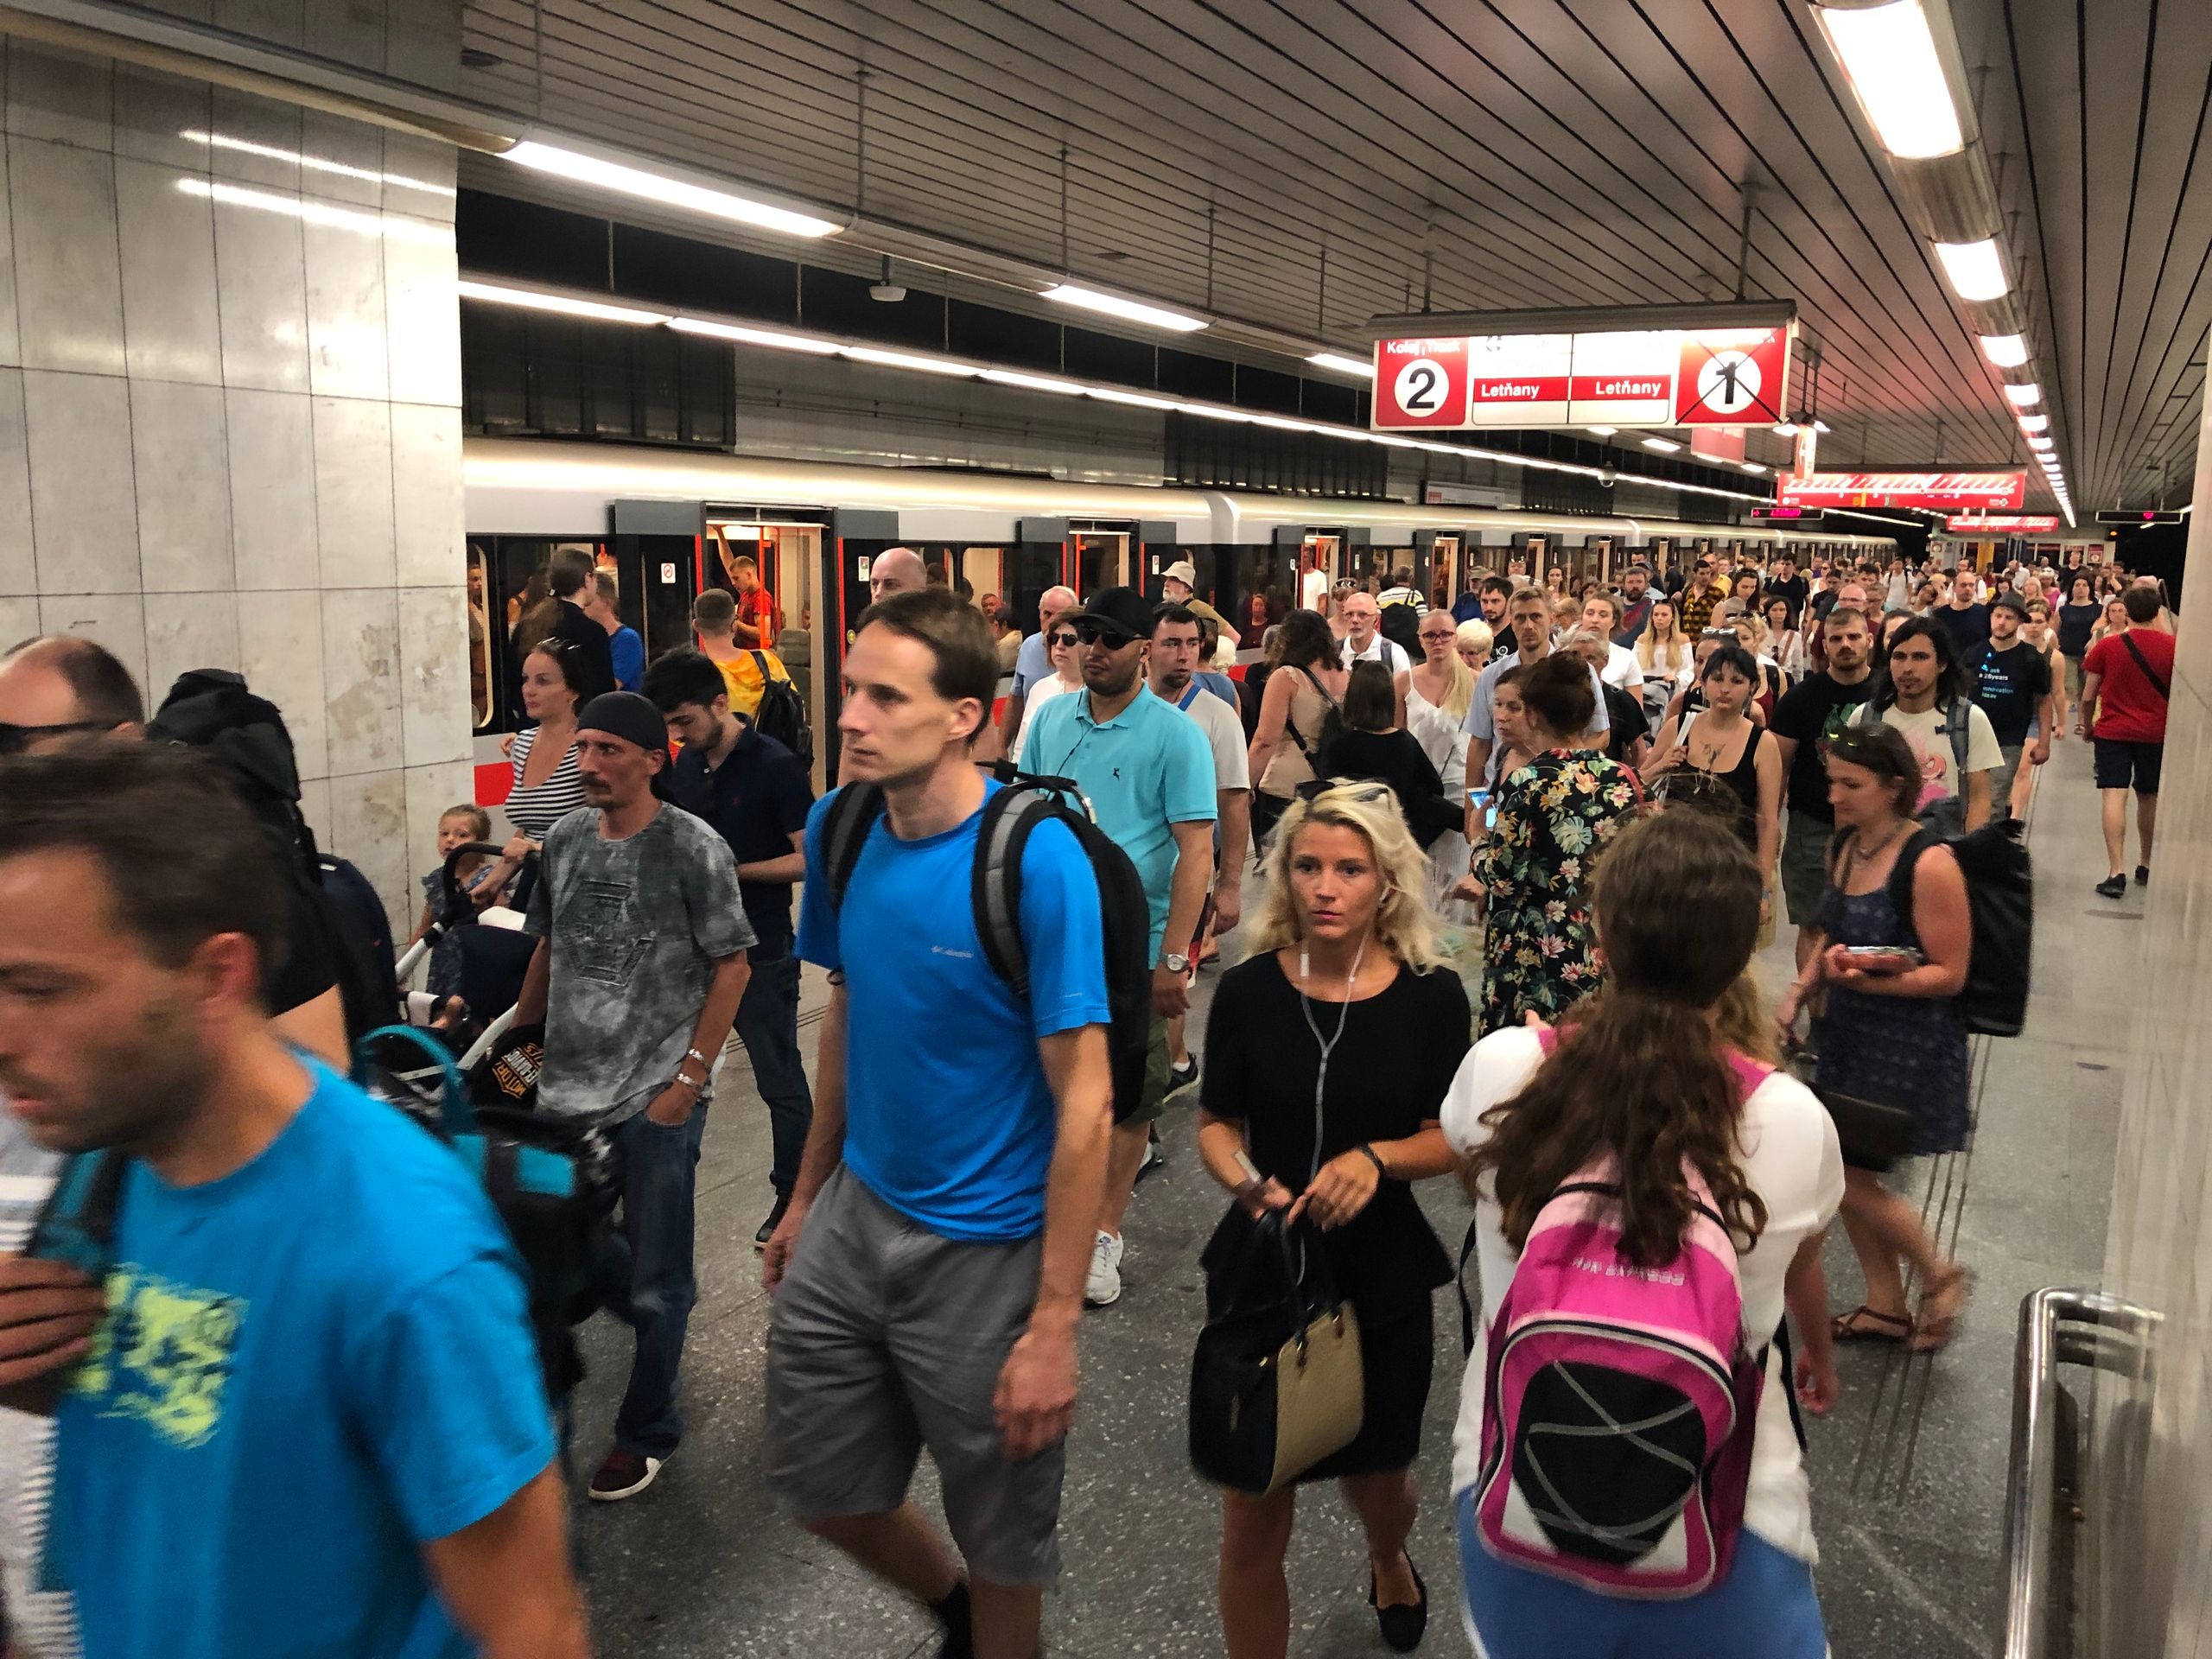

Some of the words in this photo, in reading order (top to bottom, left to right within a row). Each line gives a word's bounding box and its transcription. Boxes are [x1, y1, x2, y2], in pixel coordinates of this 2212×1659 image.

[1406, 367, 1436, 409] 2
[1481, 382, 1540, 399] Letňany
[1595, 380, 1662, 397] Letňany
[1715, 361, 1737, 404] 1
